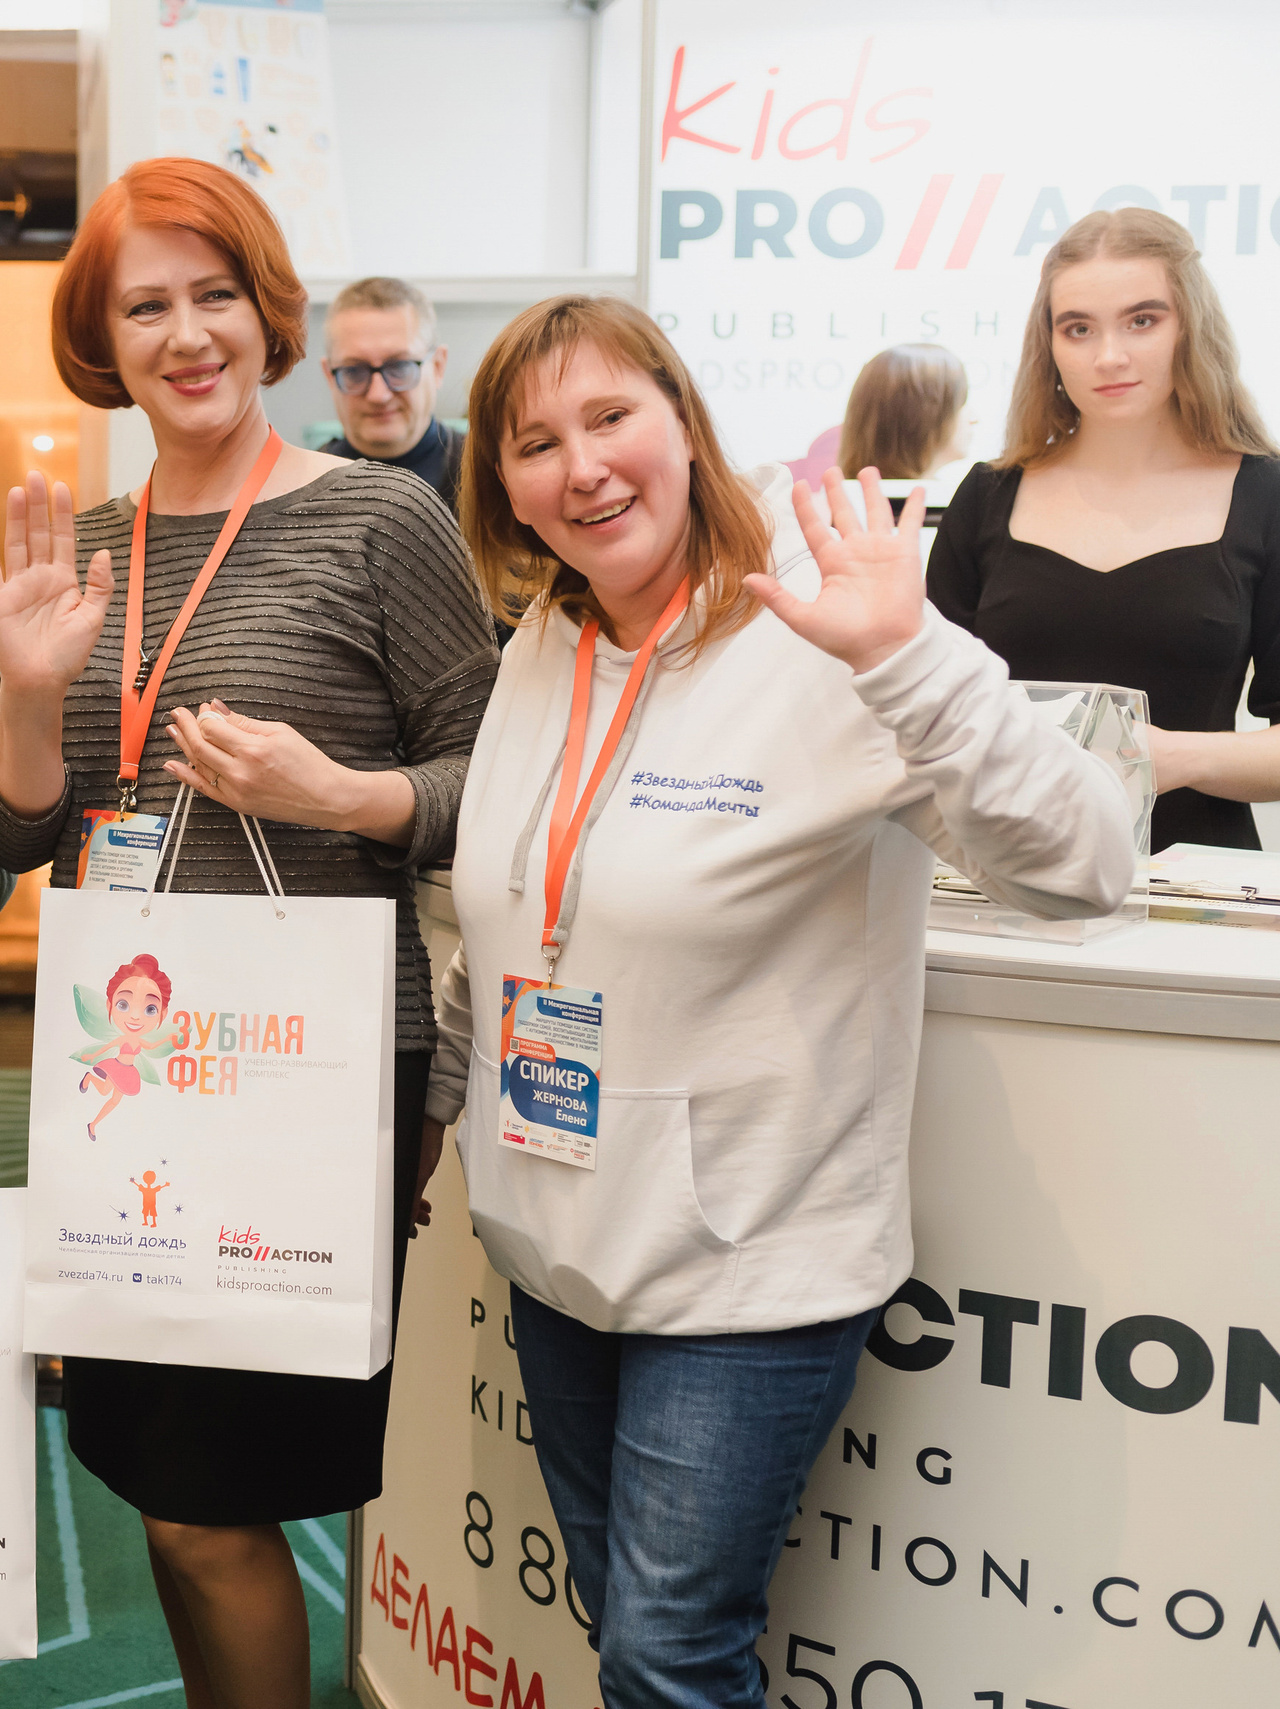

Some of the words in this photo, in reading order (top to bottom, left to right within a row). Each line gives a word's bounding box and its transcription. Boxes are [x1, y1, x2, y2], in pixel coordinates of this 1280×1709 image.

[661, 36, 934, 164] kids
[631, 771, 764, 793] #ЗвездныйДождь
[630, 794, 760, 817] #КомандаМечты
[172, 1010, 304, 1055] ЗУБНАЯ
[244, 1057, 348, 1070] УЧЕБНО-РАЗВИВАЮЩИЙ
[167, 1054, 238, 1095] ФЕЯ
[244, 1069, 290, 1080] КОМПЛЕКС
[520, 1060, 589, 1092] СПИКЕР
[533, 1089, 588, 1113] ЖЕРНОВА
[556, 1109, 587, 1127] Елена
[58, 1228, 133, 1246] Звездный
[138, 1236, 187, 1250] дождь
[218, 1225, 260, 1245] kids
[58, 1270, 123, 1282] zvezda74.ru
[146, 1274, 182, 1286] tak174
[217, 1265, 287, 1274] PUBLISHING
[216, 1275, 332, 1295] kidsproaction.com
